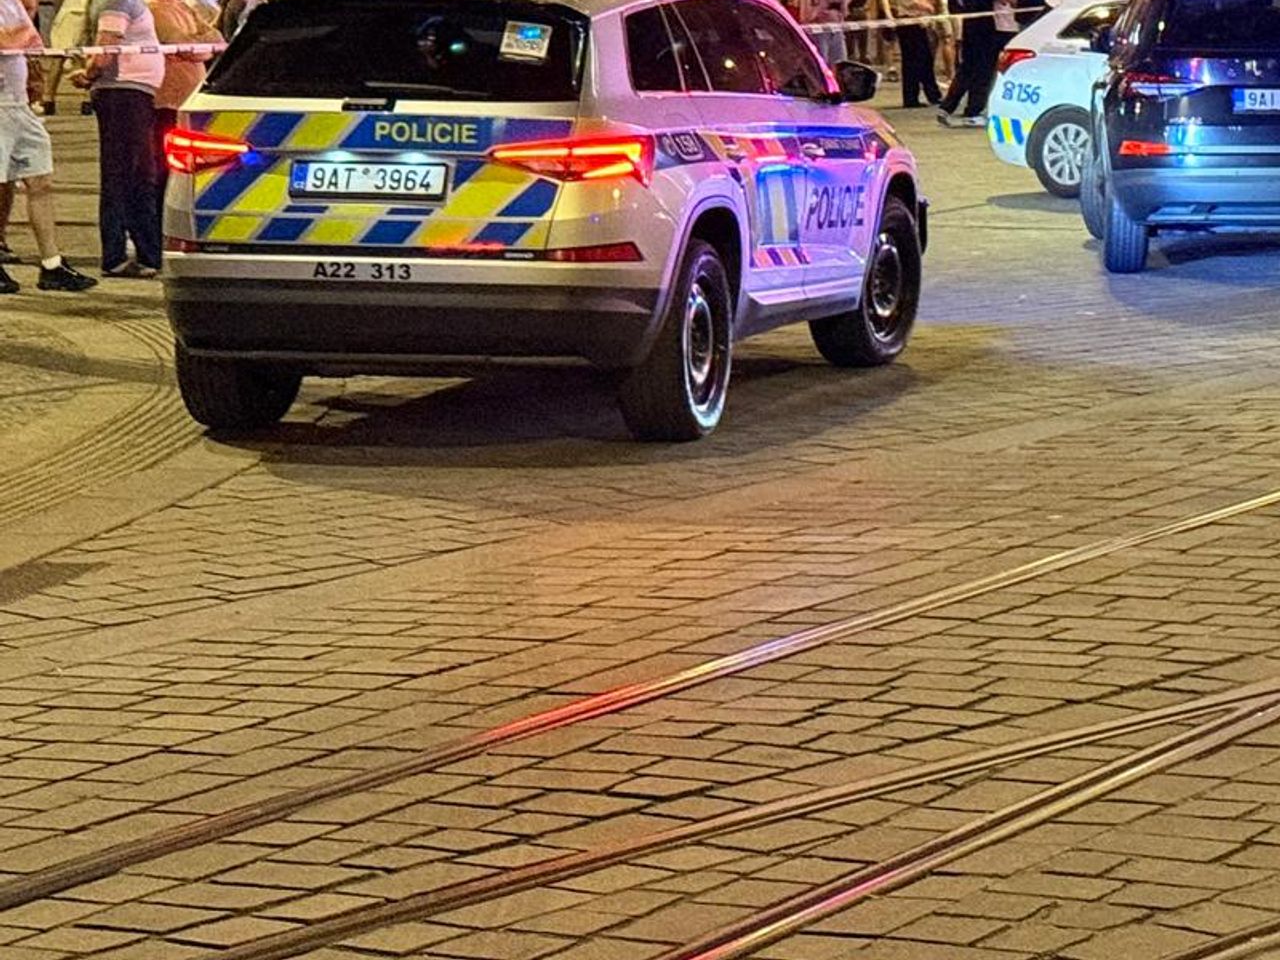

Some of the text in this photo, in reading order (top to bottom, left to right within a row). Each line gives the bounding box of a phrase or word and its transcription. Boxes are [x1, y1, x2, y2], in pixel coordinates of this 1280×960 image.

[1016, 83, 1042, 104] 156
[374, 121, 478, 144] POLICIE
[312, 167, 432, 191] 9AT 3964
[806, 185, 865, 230] POLICIE
[313, 262, 412, 279] A22 313
